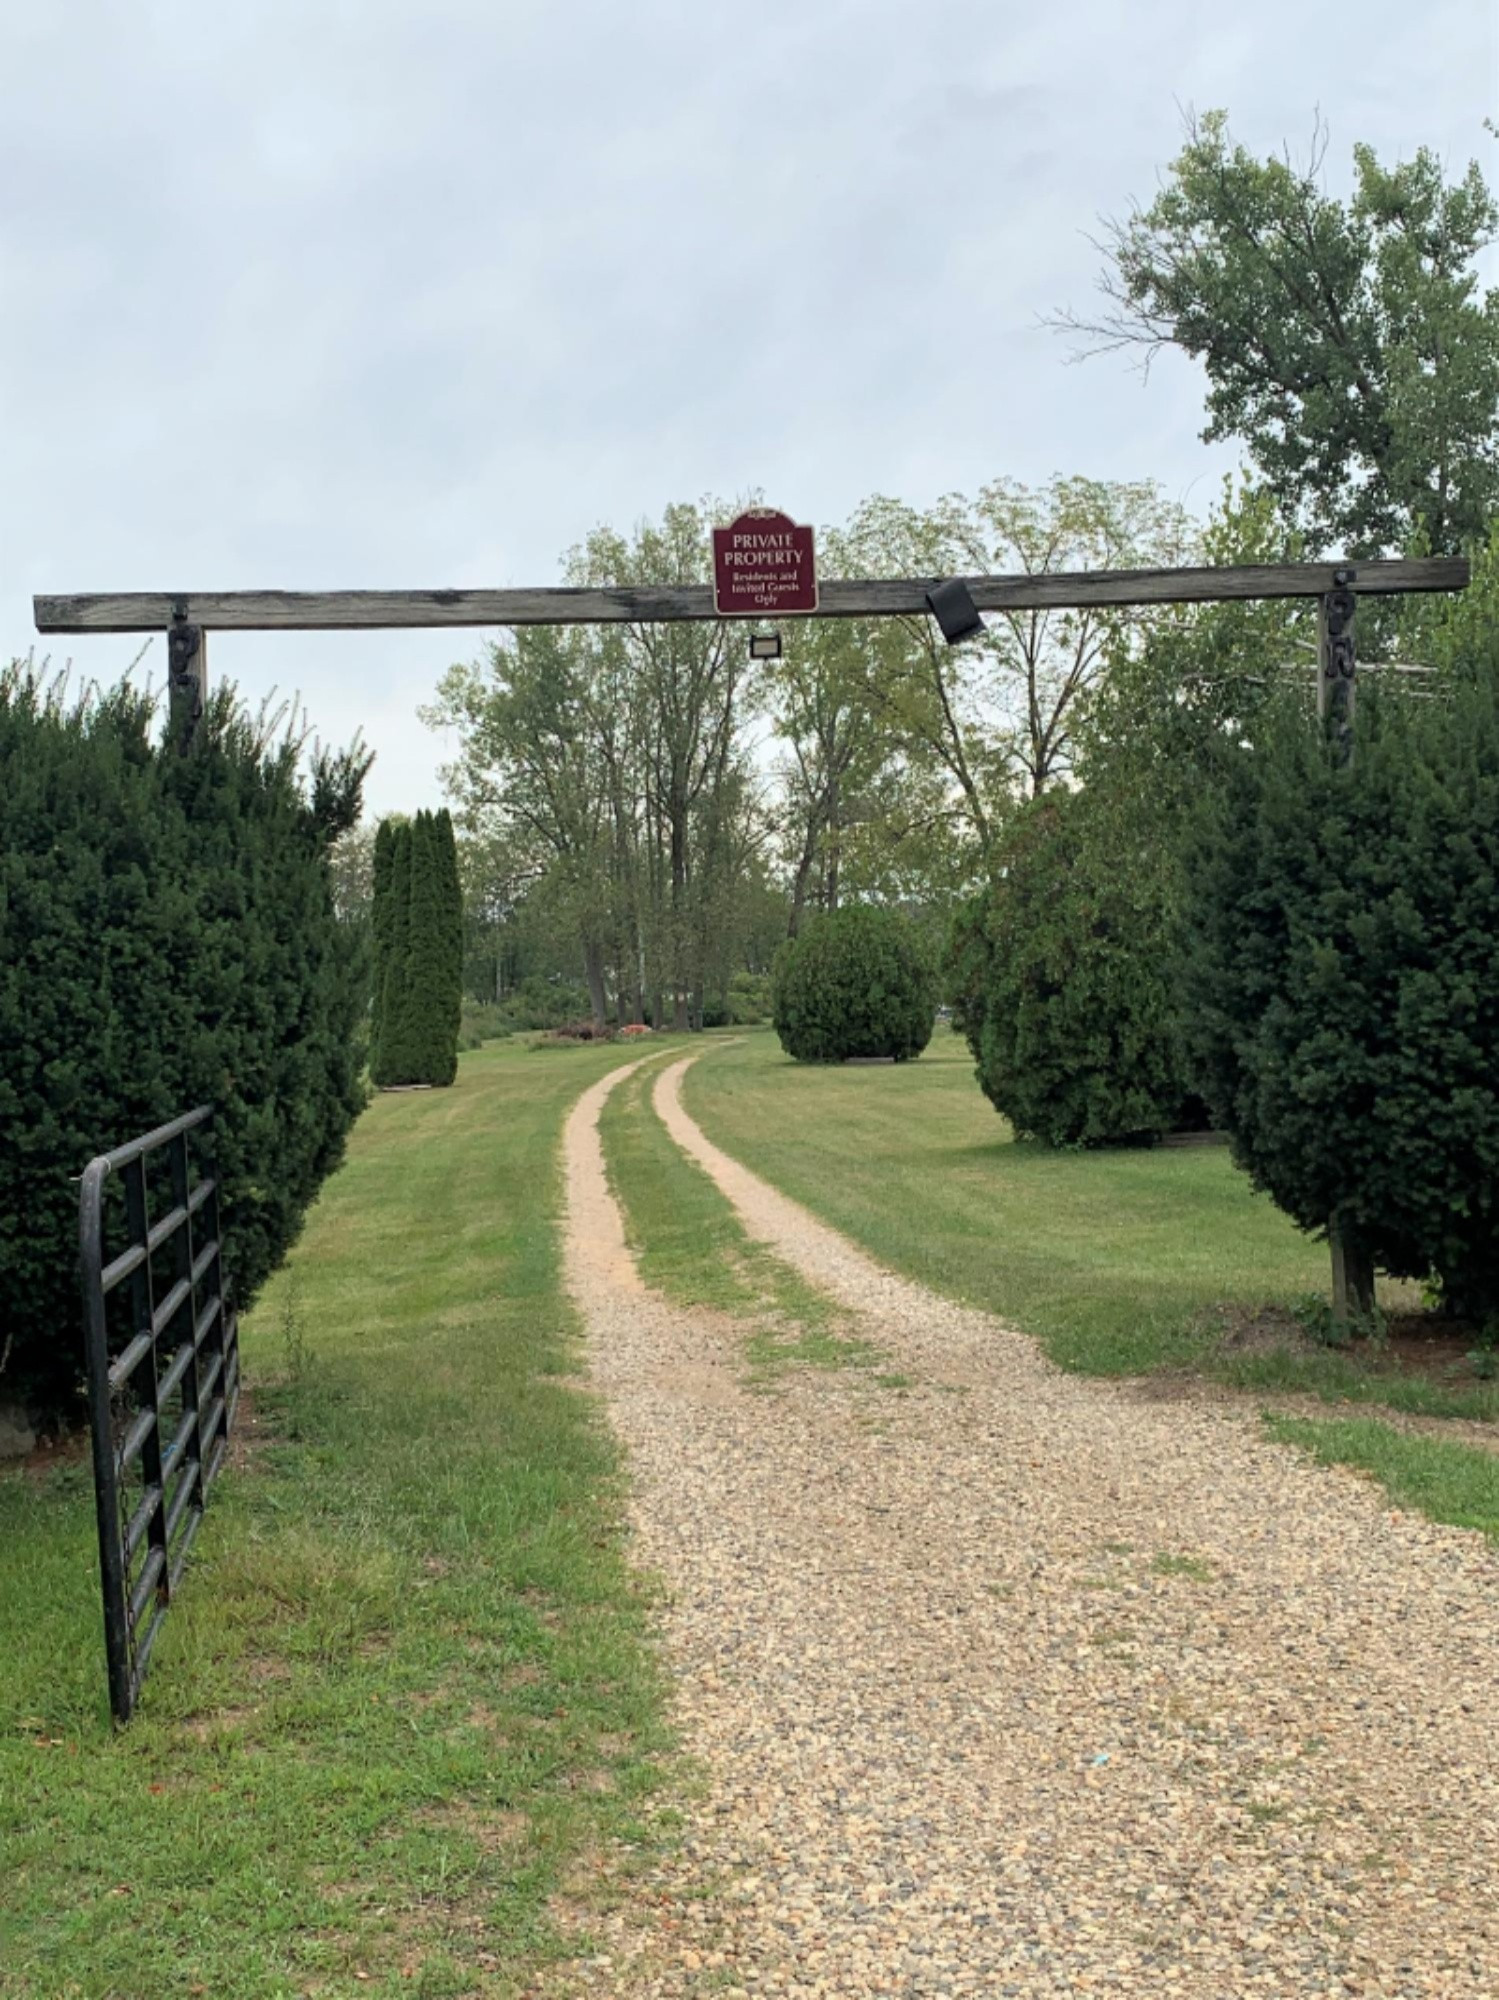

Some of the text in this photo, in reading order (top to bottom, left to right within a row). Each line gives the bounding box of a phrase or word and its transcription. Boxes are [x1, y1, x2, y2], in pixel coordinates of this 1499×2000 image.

[733, 533, 793, 548] PRIVATE
[724, 550, 803, 566] PROPERTY
[733, 569, 797, 581] Residents and
[767, 582, 800, 592] Guests
